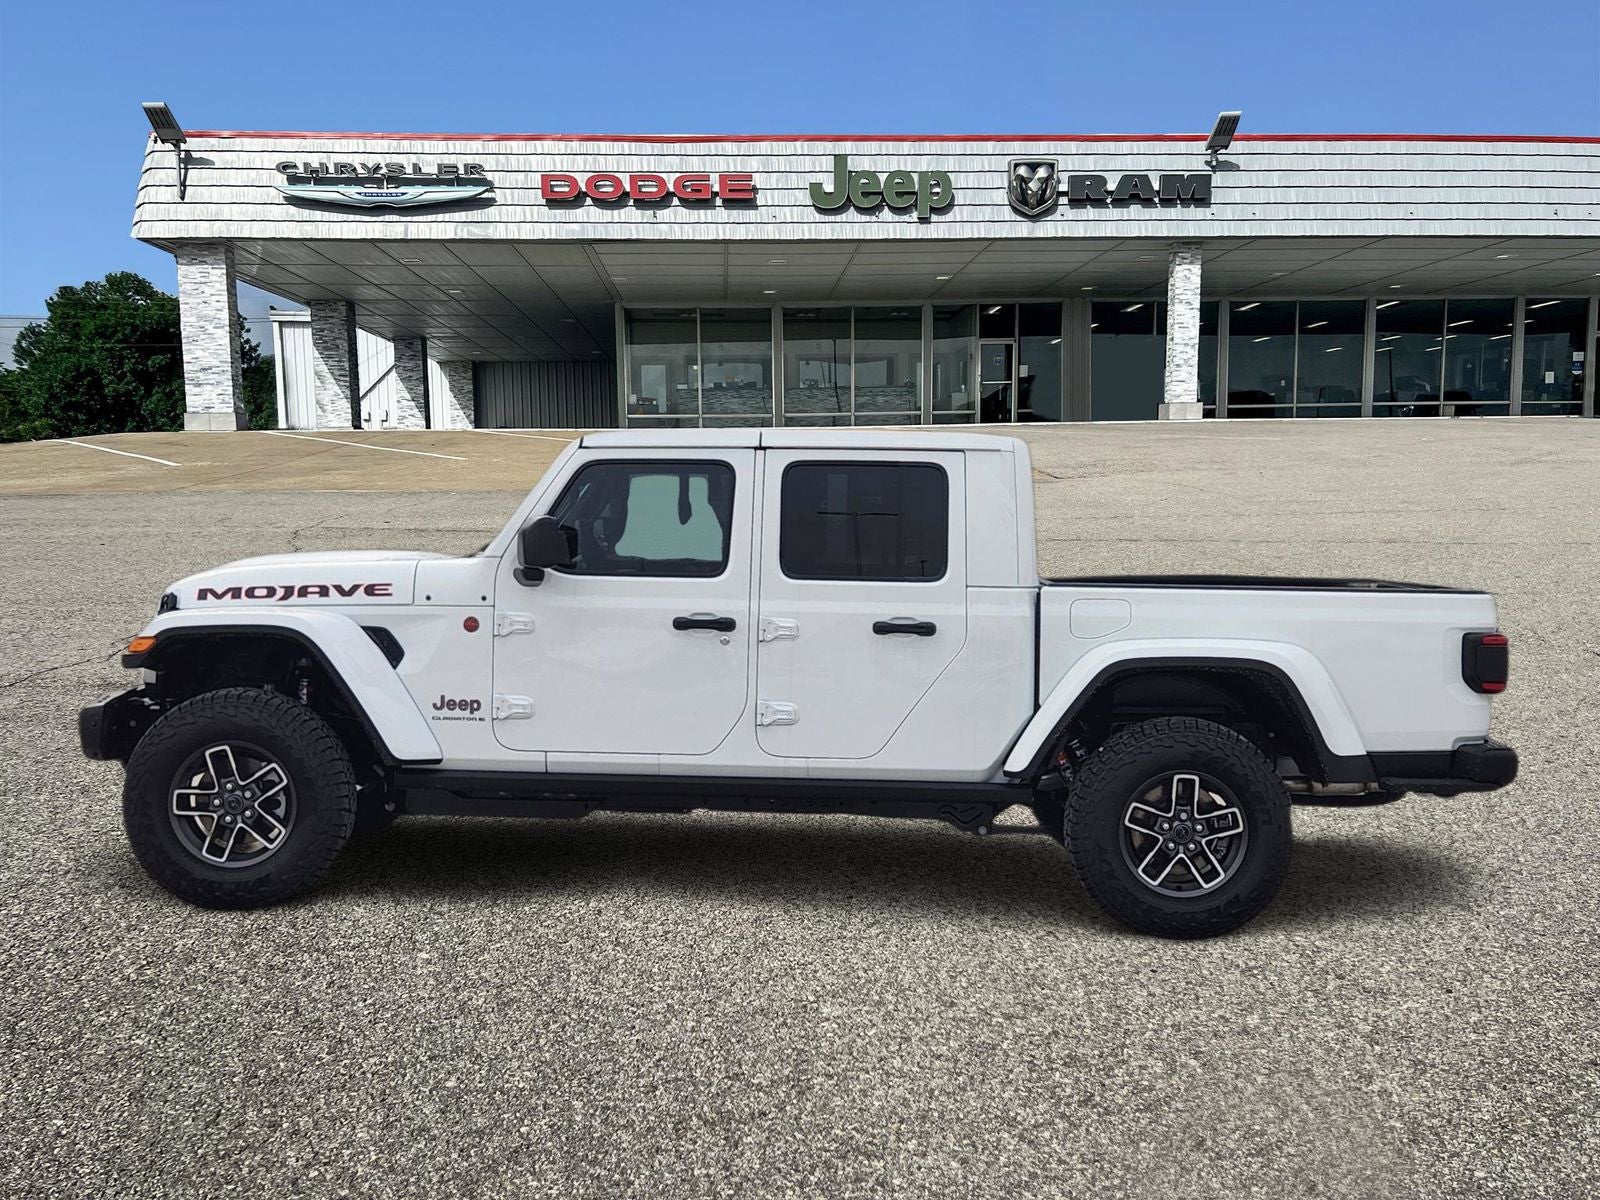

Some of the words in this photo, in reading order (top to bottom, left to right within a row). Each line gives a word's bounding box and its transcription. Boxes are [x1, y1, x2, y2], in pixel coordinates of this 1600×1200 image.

[275, 160, 486, 178] CHRYSLER
[540, 173, 754, 200] DODGE
[809, 155, 953, 218] Jeep
[1068, 173, 1212, 199] RAM
[196, 582, 394, 602] MOJAVE
[432, 694, 482, 715] Jeep
